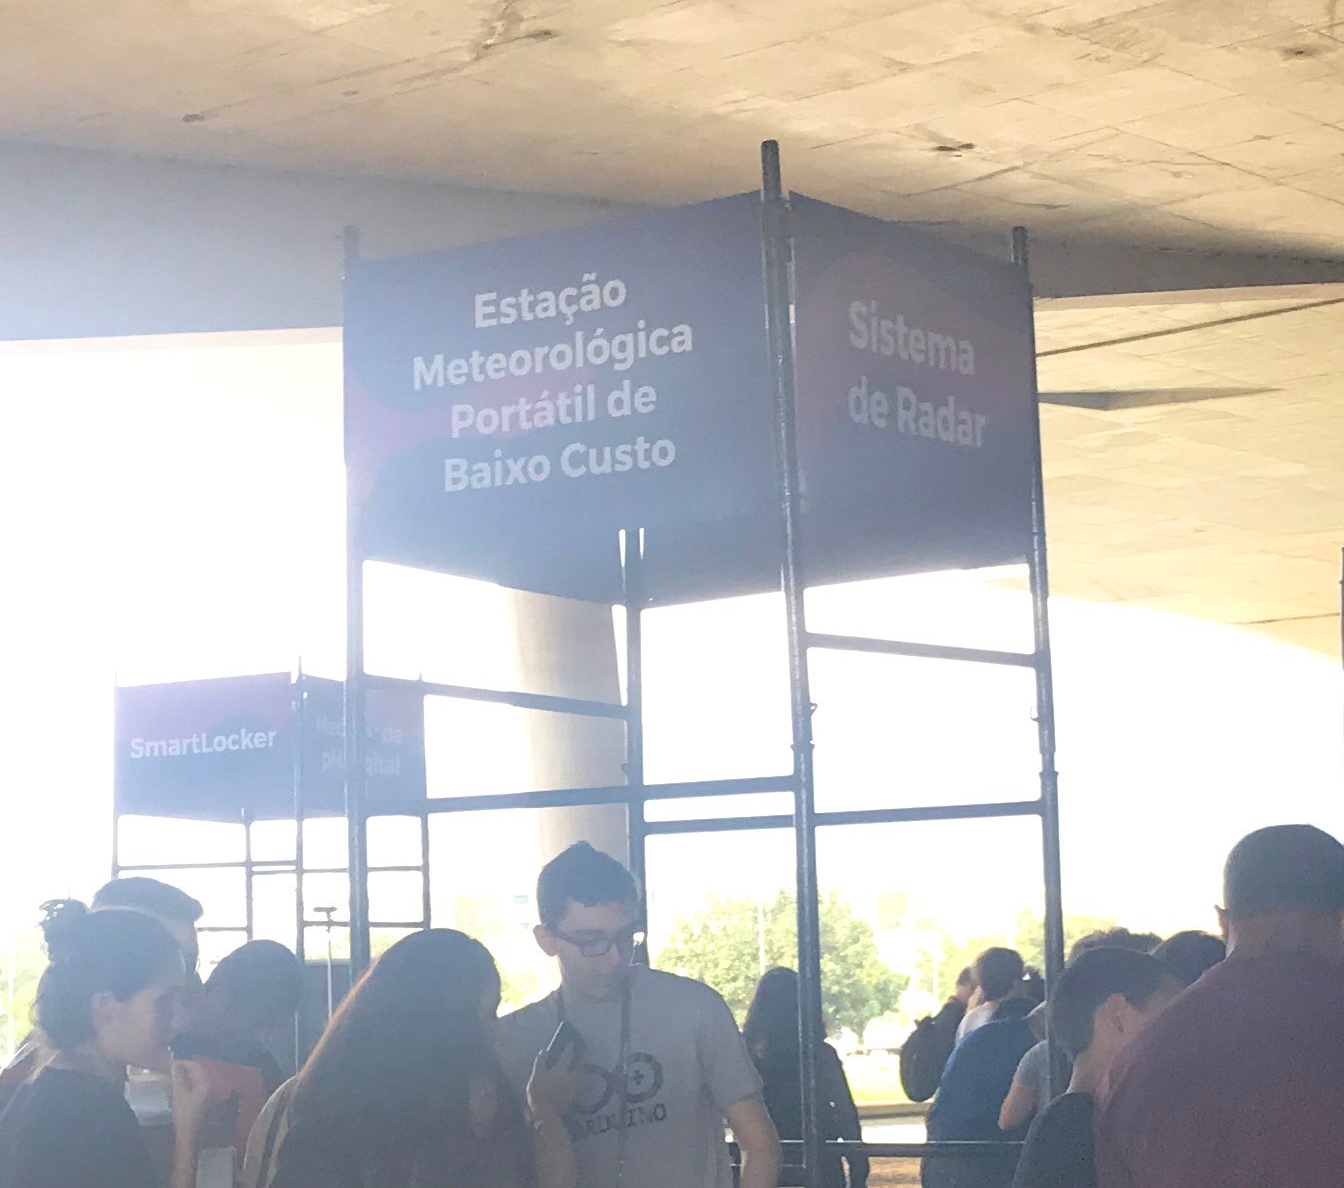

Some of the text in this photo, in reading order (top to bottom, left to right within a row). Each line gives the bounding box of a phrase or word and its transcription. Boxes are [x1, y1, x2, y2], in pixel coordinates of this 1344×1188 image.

[474, 271, 627, 330] Estação
[412, 319, 694, 391] Meteorológica
[848, 300, 976, 377] Sistema
[451, 376, 658, 439] Portátil de
[848, 376, 987, 449] de Radar
[444, 434, 676, 493] Baixo Custo
[130, 728, 277, 759] SmartLocker
